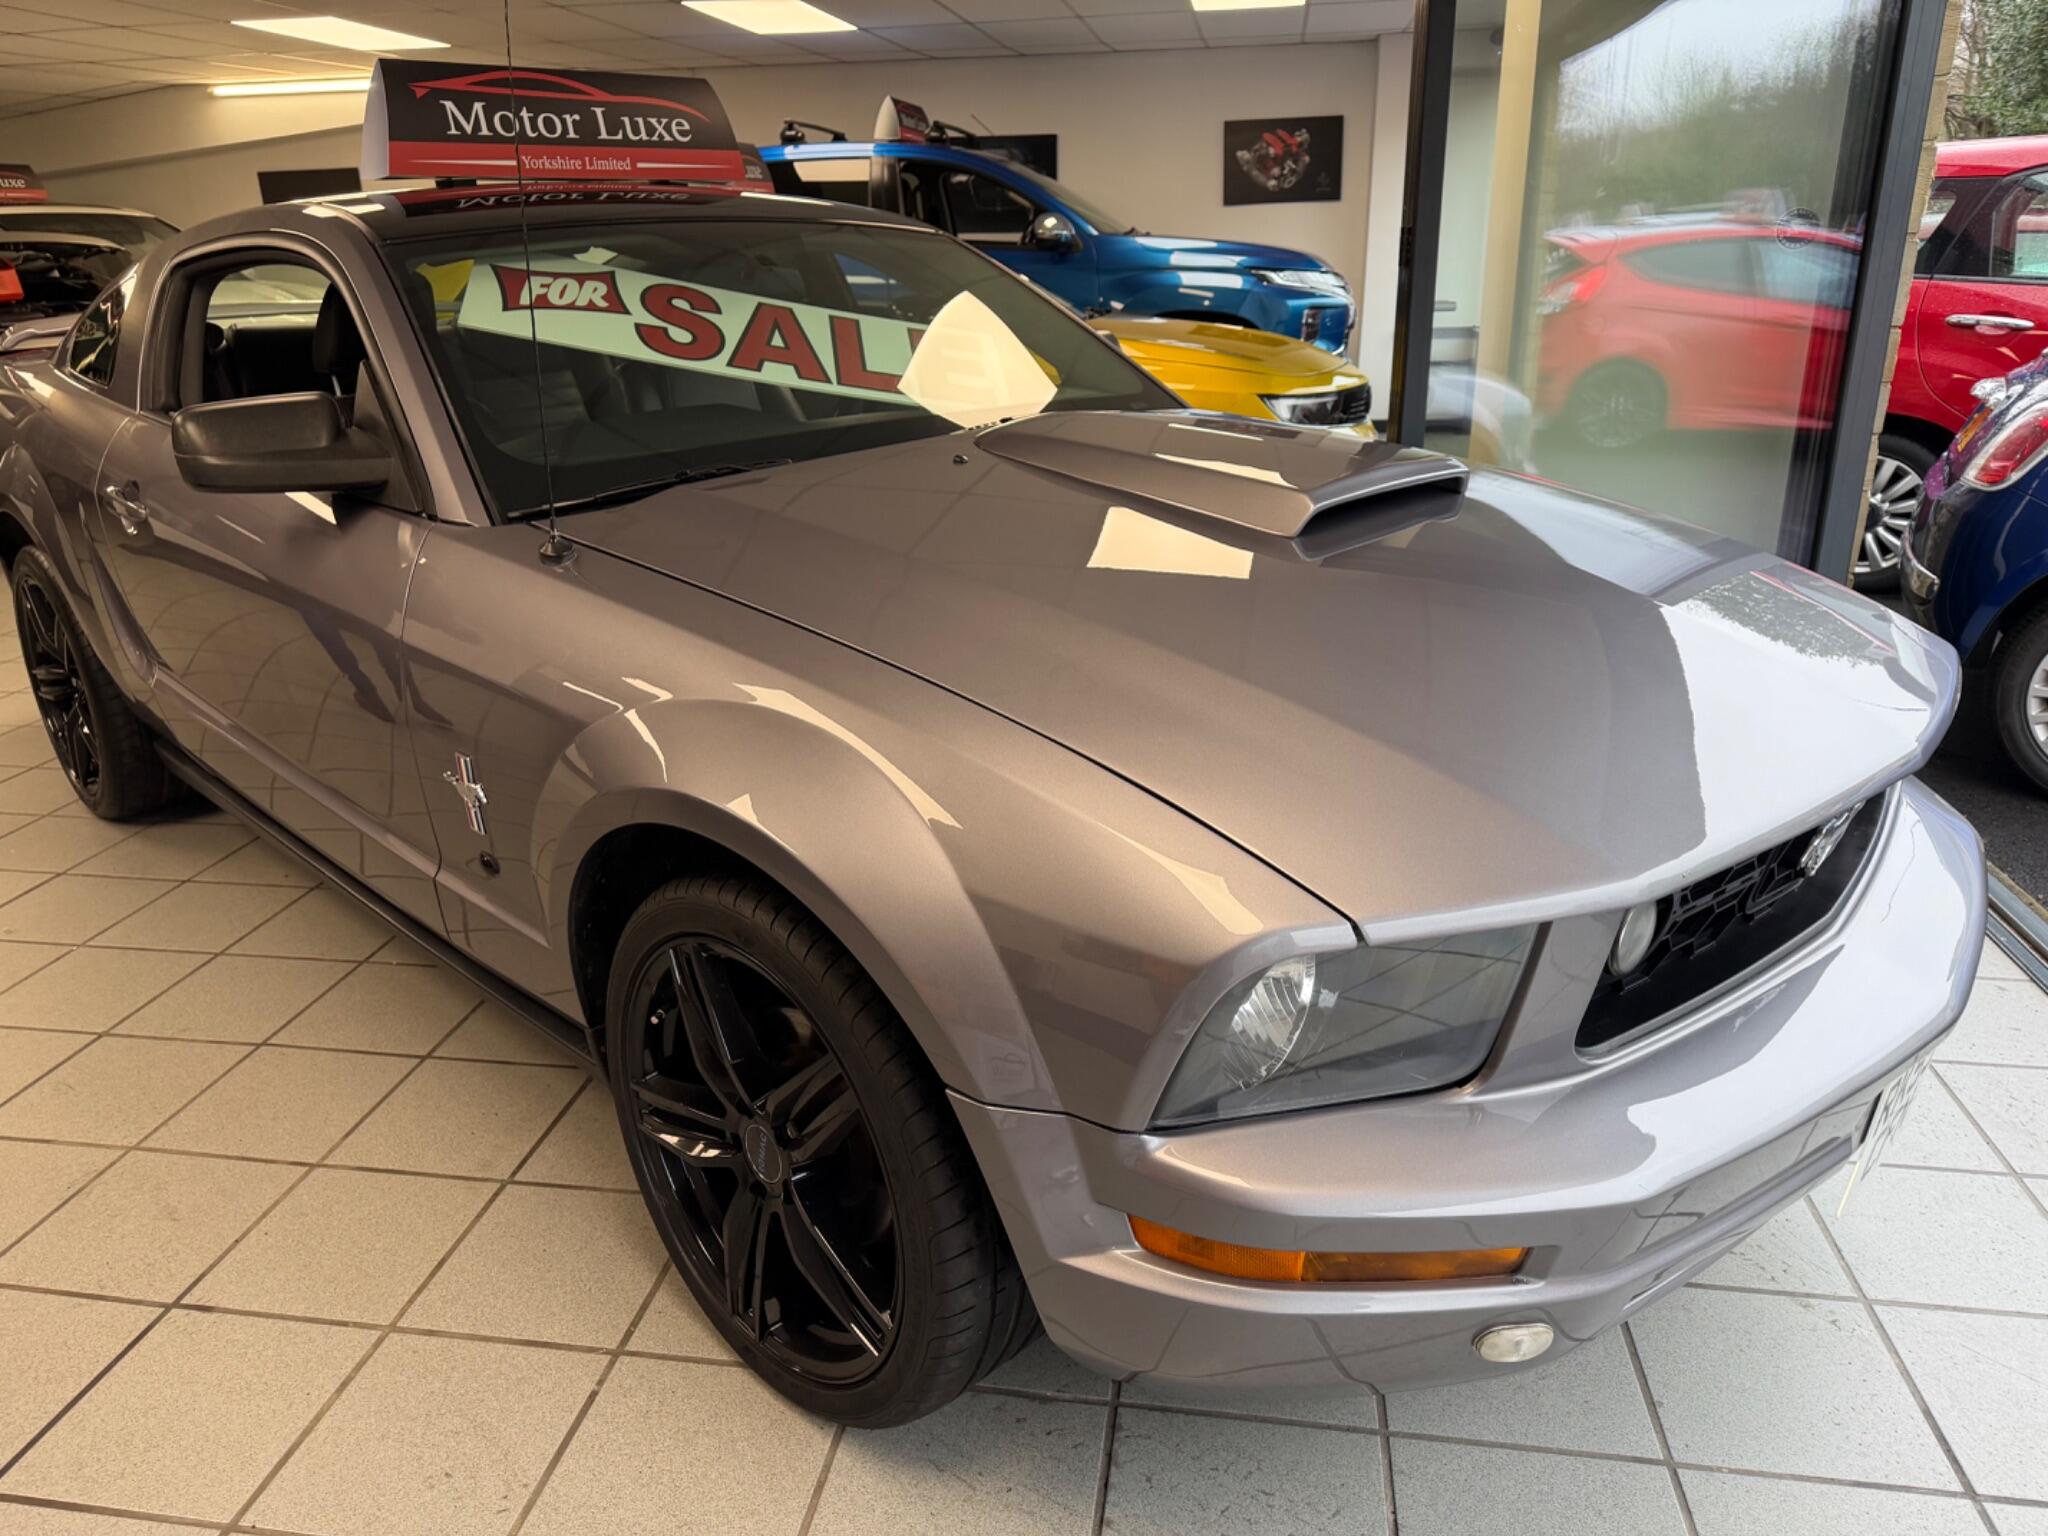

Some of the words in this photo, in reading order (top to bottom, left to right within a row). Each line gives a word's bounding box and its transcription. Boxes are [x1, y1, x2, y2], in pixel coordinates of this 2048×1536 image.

[440, 100, 581, 139] Motor
[591, 107, 693, 142] Luxe
[521, 155, 582, 170] Yorkshire
[585, 156, 632, 171] Limited
[519, 275, 610, 308] FOR
